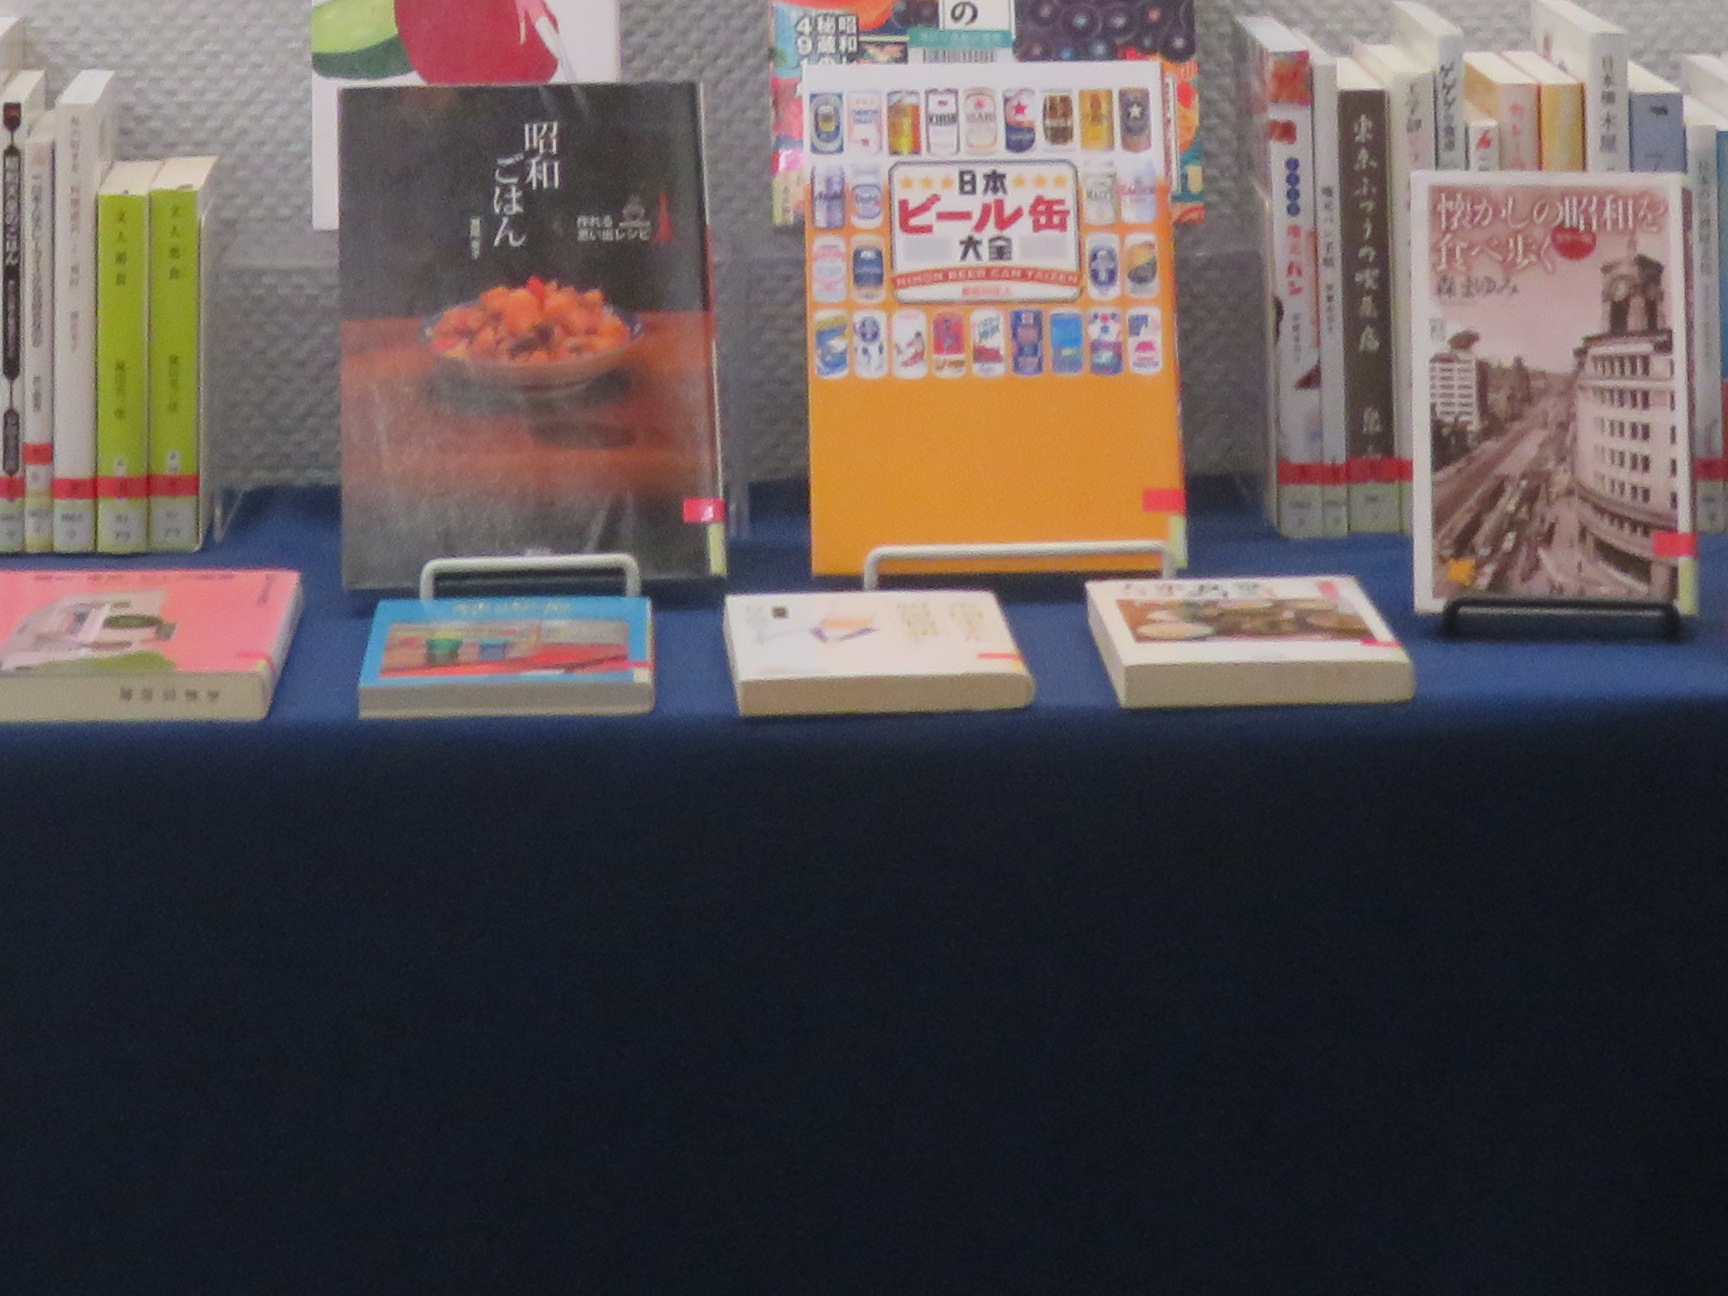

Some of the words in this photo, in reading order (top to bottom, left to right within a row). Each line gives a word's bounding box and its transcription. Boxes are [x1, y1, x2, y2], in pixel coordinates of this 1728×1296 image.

[523, 119, 560, 191] 昭和
[492, 153, 526, 249] ごはん
[958, 169, 1009, 196] 日本
[898, 194, 1070, 235] ビール缶
[1436, 190, 1664, 235] 懐かしの昭和を
[959, 235, 1014, 263] 大全
[1435, 233, 1555, 274] 食べ歩く
[895, 270, 944, 287] NIHON
[949, 267, 986, 281] BEER
[990, 268, 1023, 282] CAN
[1026, 270, 1078, 286] TAIZEN
